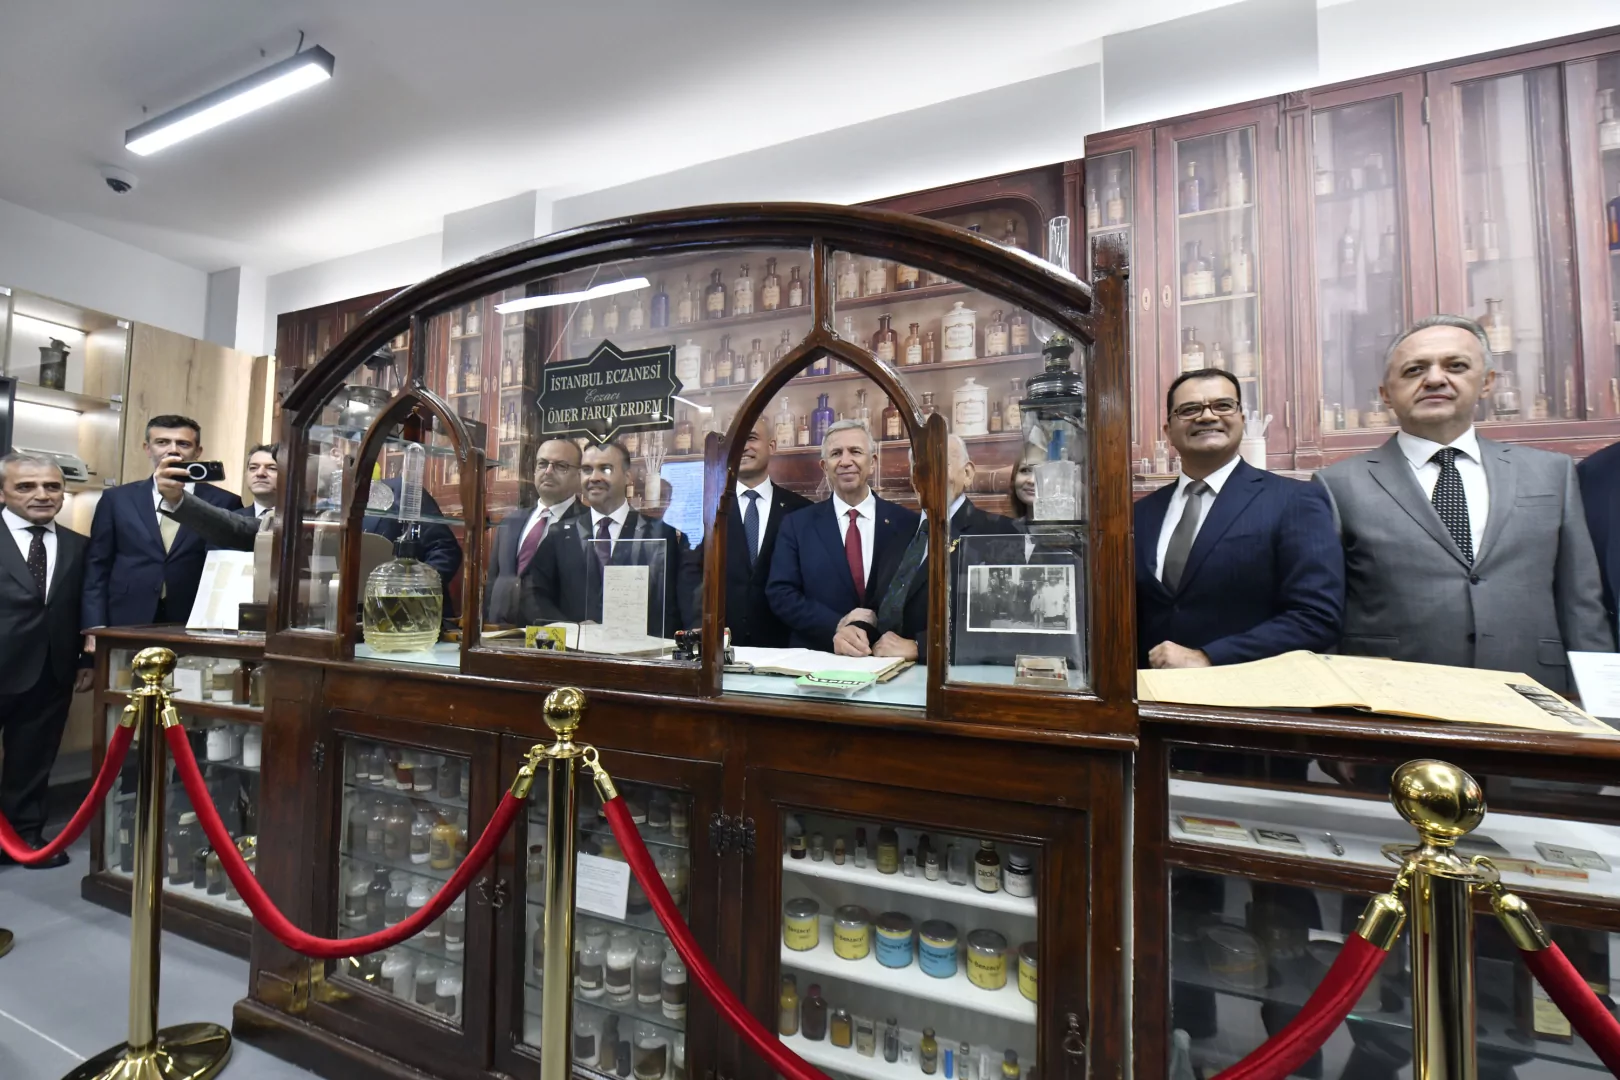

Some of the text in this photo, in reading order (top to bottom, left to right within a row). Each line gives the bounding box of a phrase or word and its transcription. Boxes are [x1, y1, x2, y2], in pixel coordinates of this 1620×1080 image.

[550, 360, 661, 391] İSTANBUL ECZANESİ
[584, 388, 620, 403] Eczacı
[547, 399, 662, 424] ÖMER FARUK ERDEM
